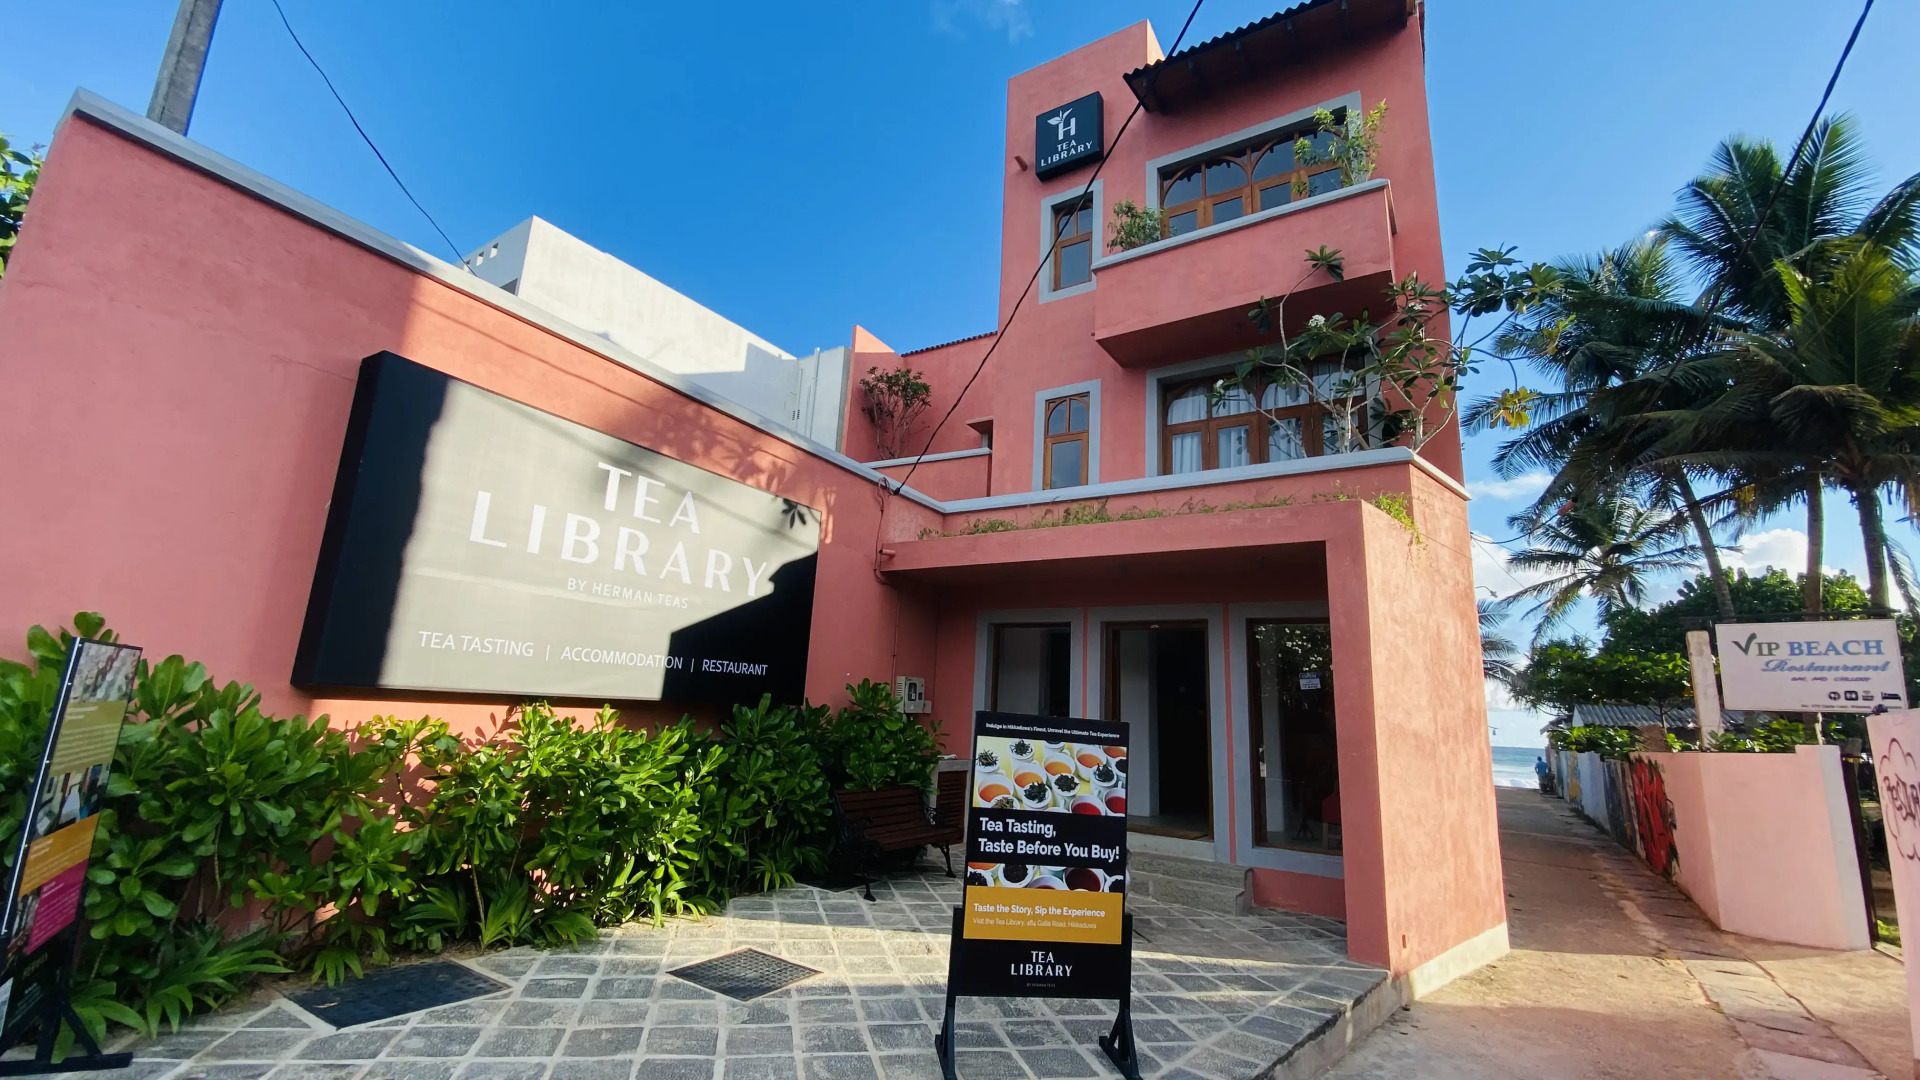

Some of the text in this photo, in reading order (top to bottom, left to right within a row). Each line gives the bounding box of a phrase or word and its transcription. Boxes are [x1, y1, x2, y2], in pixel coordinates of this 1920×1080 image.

[1041, 141, 1093, 167] LIBRARY
[1057, 140, 1077, 152] TEA
[598, 462, 701, 534] TEA
[469, 490, 767, 597] LIBRARY
[567, 578, 688, 609] BY HERMAN TEAS
[418, 631, 768, 676] TEA TASTING ACCOMMODATION RESTAURANT
[1731, 632, 1885, 656] VIP BEACH
[1761, 658, 1891, 673] Restaurant
[1097, 731, 1120, 739] Experience
[980, 817, 1056, 838] Tea Tasting,
[978, 838, 1120, 863] Taste Before You Buy!
[973, 903, 1106, 917] Taste the Story, Sip the Experience
[973, 917, 984, 925] Visit
[1030, 950, 1055, 963] TEA
[1010, 963, 1073, 977] LIBRARY
